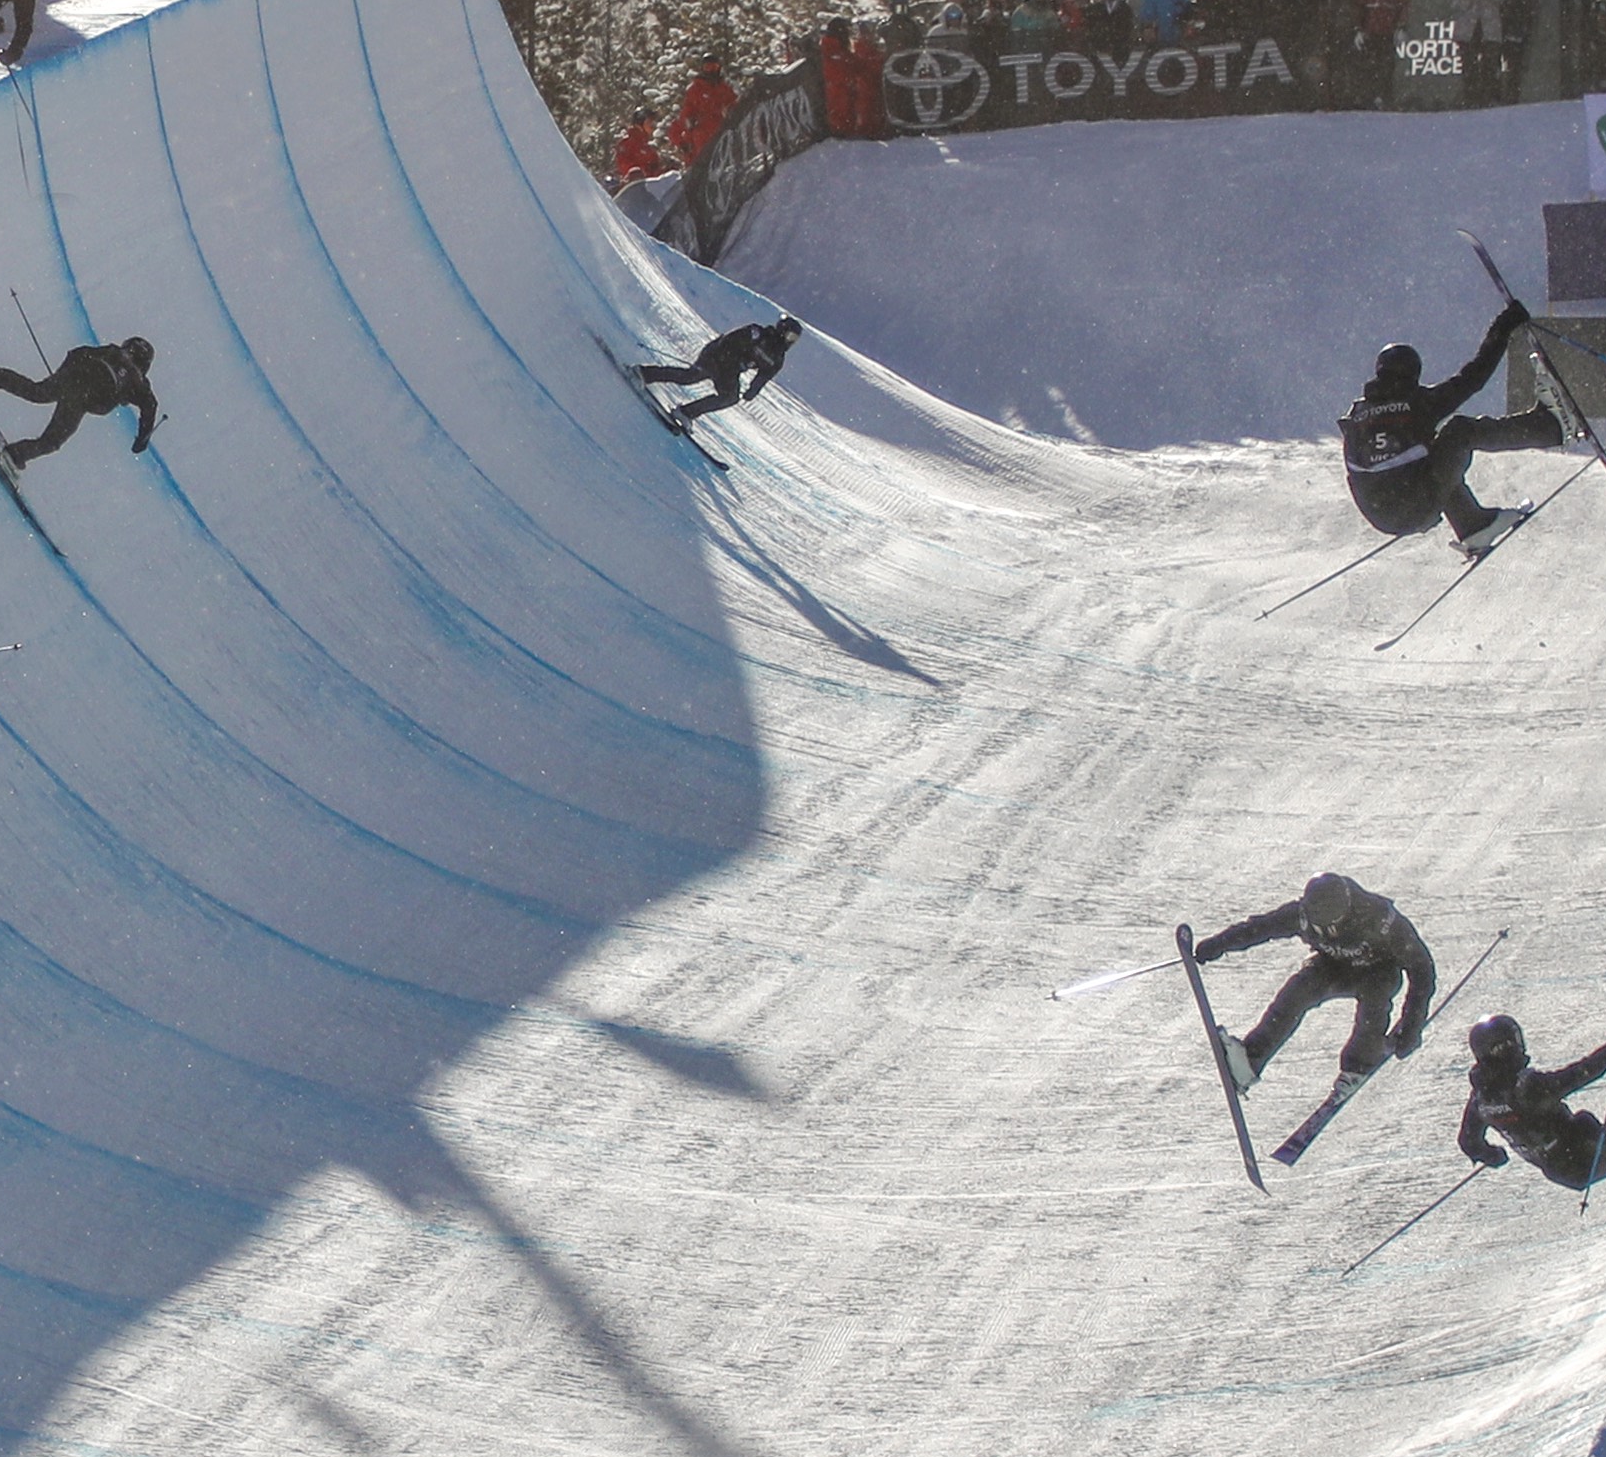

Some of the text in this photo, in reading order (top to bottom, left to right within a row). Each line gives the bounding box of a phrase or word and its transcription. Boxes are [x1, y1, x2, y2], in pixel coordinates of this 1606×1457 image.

[999, 38, 1294, 103] TOYOTA
[1405, 57, 1463, 76] FACE
[1367, 402, 1411, 416] TOYOTA
[1374, 432, 1387, 449] 5
